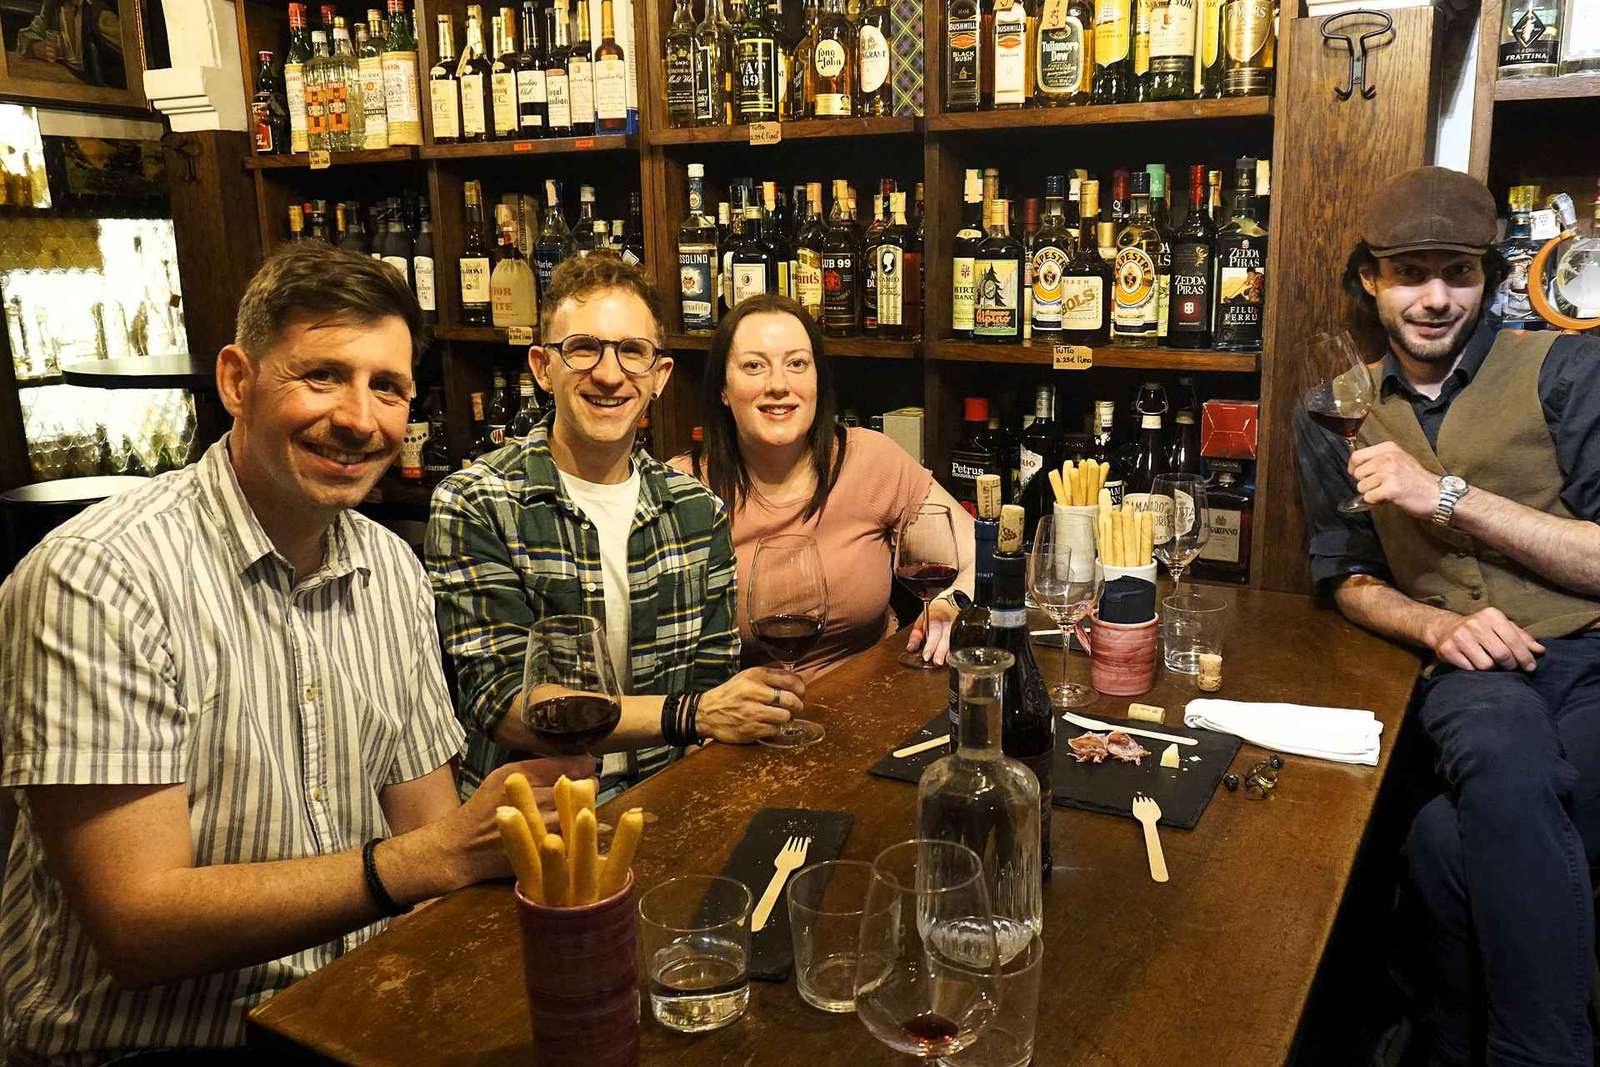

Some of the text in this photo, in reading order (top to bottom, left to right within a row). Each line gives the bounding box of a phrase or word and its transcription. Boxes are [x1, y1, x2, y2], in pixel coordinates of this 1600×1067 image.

[952, 50, 975, 58] BLACK
[1505, 52, 1547, 61] FRATTINA
[739, 61, 766, 75] VAT
[742, 74, 759, 87] 69
[1229, 247, 1260, 258] ZEDDA
[837, 258, 852, 269] 99
[1033, 250, 1067, 275] ALPESTR
[1115, 252, 1153, 278] ALPESTRE
[1229, 256, 1260, 267] PIRAS
[1174, 274, 1207, 285] ZEDDA
[1176, 284, 1205, 295] PIRAS
[1061, 288, 1096, 316] BOLS
[951, 461, 985, 476] Petrus
